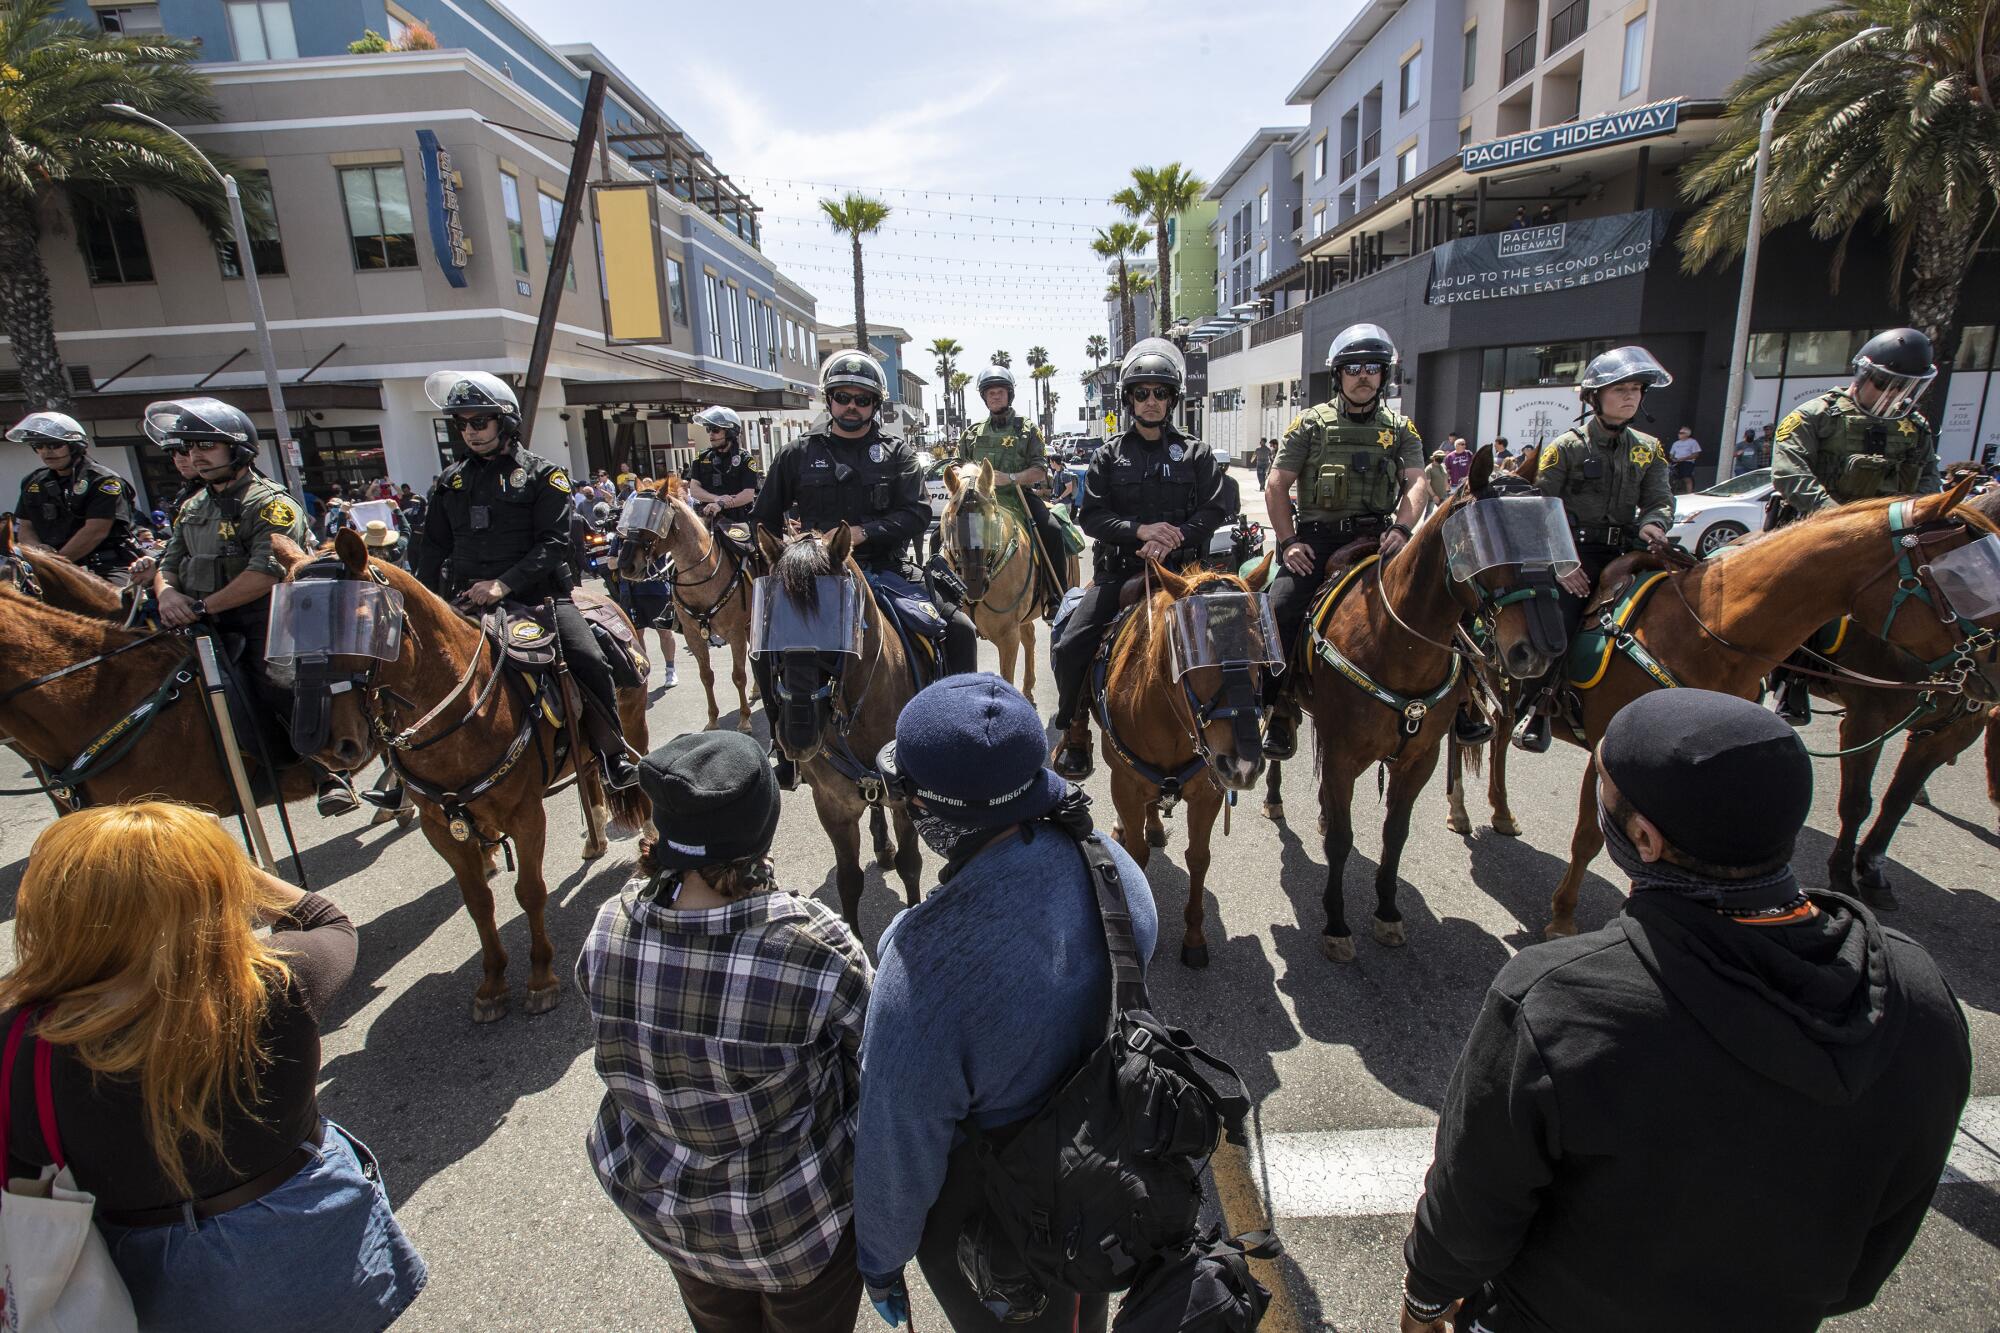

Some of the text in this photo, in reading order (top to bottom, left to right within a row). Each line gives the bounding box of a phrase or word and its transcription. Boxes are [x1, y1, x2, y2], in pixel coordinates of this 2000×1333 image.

[1466, 106, 1671, 166] PACIFIC HIDEAWAY
[438, 151, 468, 267] STRAND
[1502, 238, 1560, 254] HIDEAWAY
[1503, 226, 1561, 244] PACIFIC
[1456, 274, 1475, 285] UP
[1479, 272, 1497, 283] TO
[1501, 267, 1530, 280] THE
[1534, 255, 1599, 276] SECOND
[1447, 284, 1529, 303] EXCELLENT
[1534, 277, 1575, 292] EATS
[1527, 418, 1553, 427] FOR
[489, 741, 526, 783] POLICE
